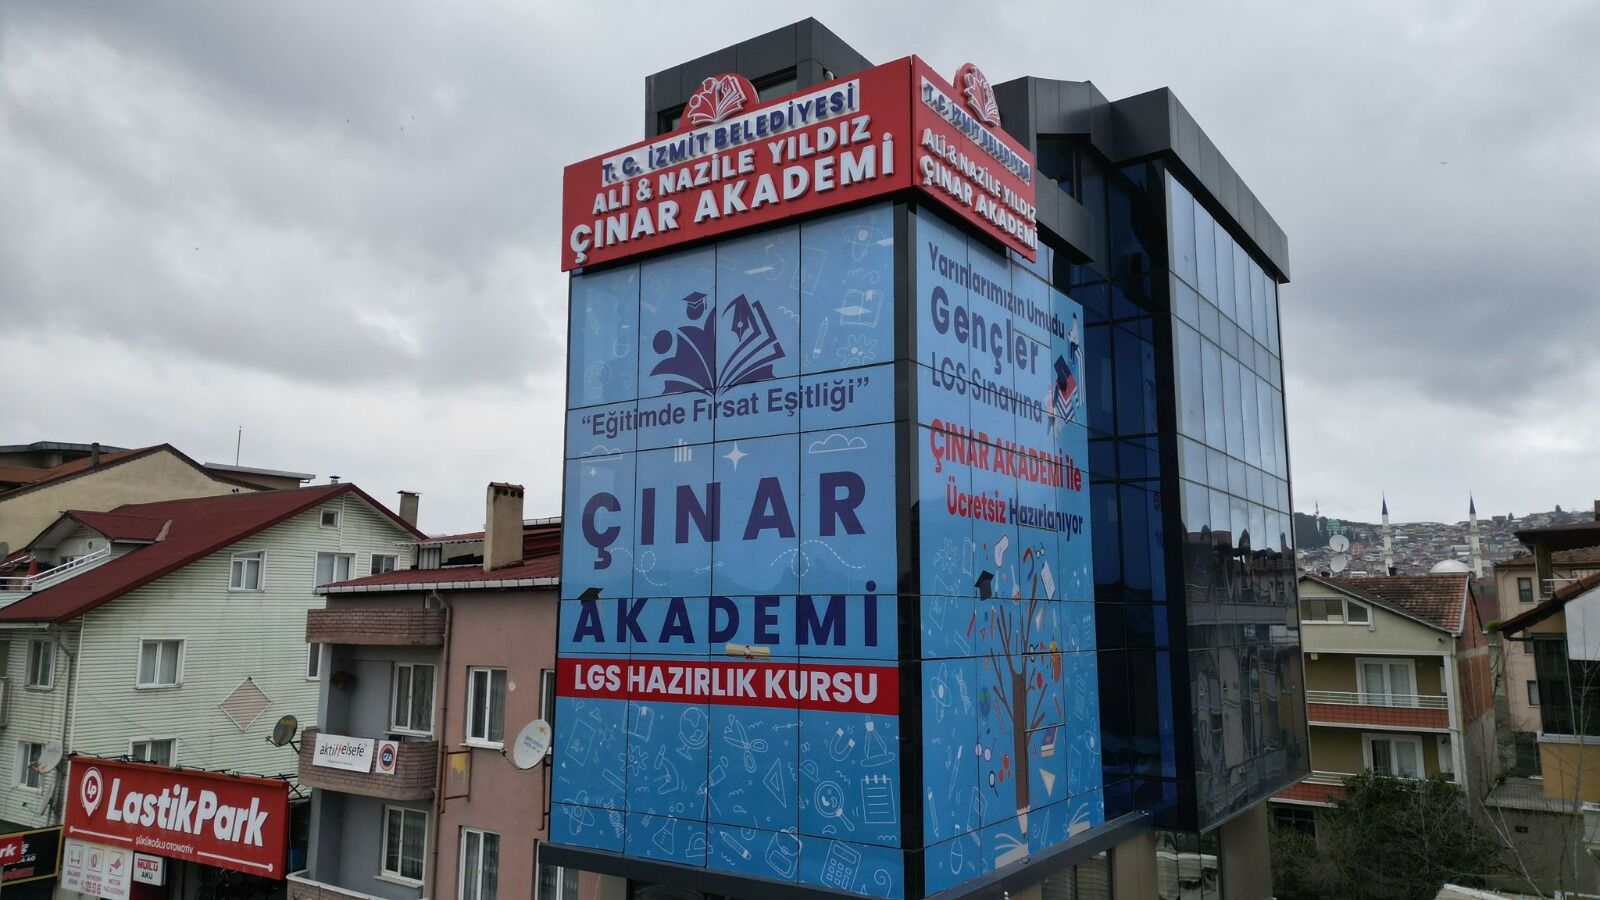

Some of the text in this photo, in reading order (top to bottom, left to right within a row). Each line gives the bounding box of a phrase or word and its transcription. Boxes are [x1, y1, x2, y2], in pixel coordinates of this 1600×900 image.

[592, 115, 872, 215] ALİ & NAZİLE YILDIZ
[648, 132, 710, 169] İZMİT
[714, 83, 855, 149] BELEDİYESİ
[570, 132, 894, 264] ÇINAR AKADEMİ
[920, 155, 1038, 251] ÇINAR AKADEMİ
[922, 128, 1037, 224] ALİ & NAZİLE YILDIZ
[929, 242, 1065, 340] Yarınlarımızın Umudu
[930, 286, 1039, 375] Gençler
[693, 396, 759, 422] Fırsat
[932, 352, 1042, 423] LGS Sınavına
[930, 418, 1082, 492] ÇINAR AKADEMİ ile
[581, 471, 866, 570] ÇINAR
[946, 476, 1083, 541] Ücretsiz Hazırlanıyor
[572, 580, 878, 647] AKADEMİ
[574, 664, 878, 704] LGS HAZIRLIK KURSU
[166, 842, 194, 855] OTOMOTİV
